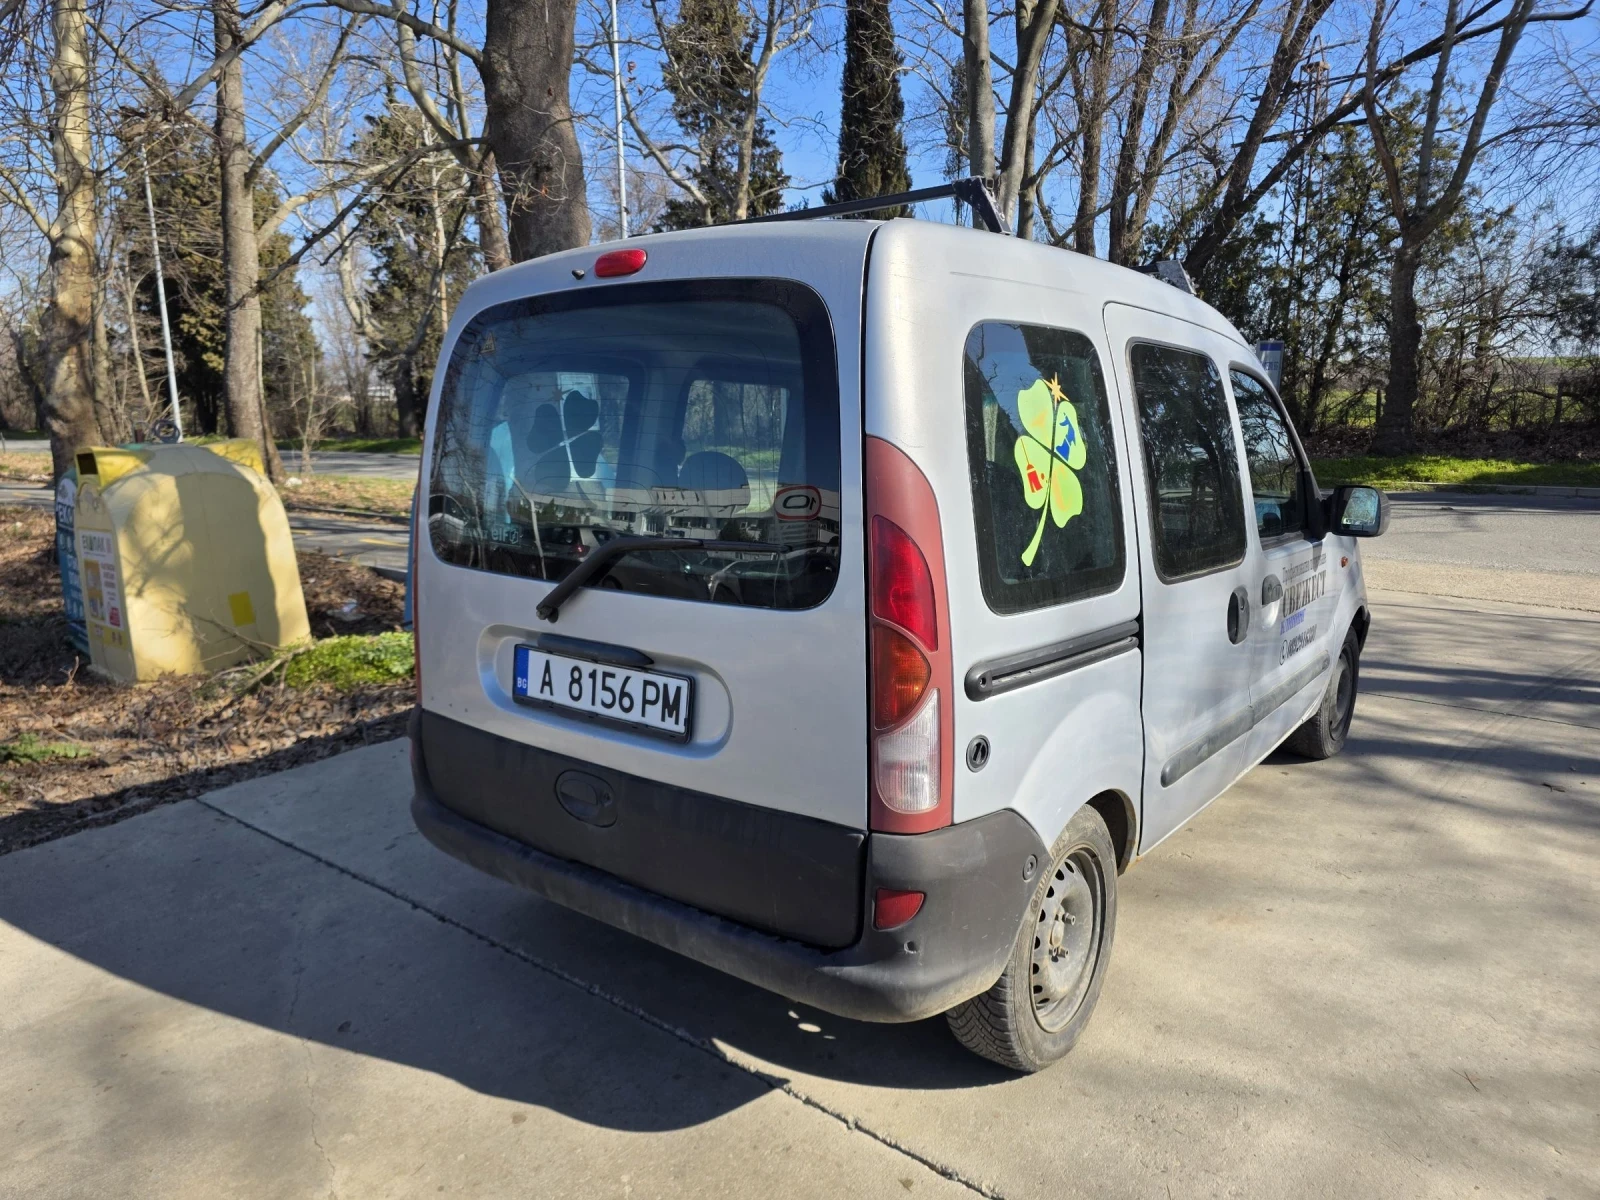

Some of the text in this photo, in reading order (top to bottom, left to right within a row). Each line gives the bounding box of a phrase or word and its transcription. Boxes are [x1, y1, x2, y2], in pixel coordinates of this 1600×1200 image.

[517, 676, 527, 689] BG
[540, 659, 682, 726] A 8156 PM
